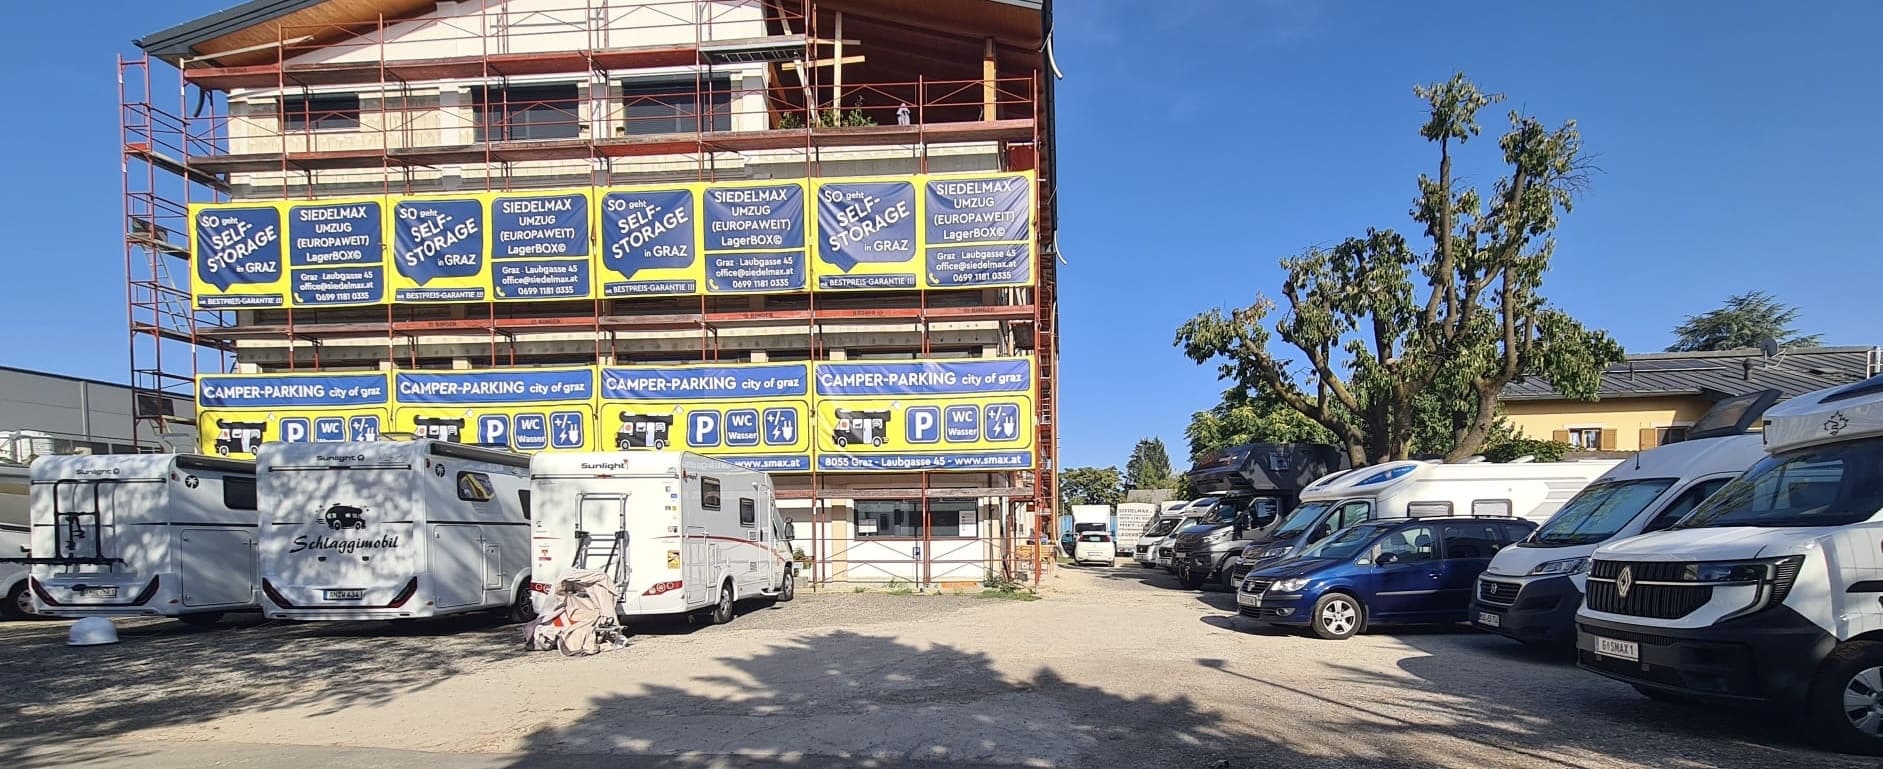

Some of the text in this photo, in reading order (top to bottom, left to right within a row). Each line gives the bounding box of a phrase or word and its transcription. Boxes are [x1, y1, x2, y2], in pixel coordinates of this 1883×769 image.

[937, 181, 1012, 195] SIEDELMAX
[715, 189, 787, 203] SIEDELMAX
[825, 191, 864, 203] SO geht
[503, 199, 572, 213] SIEDELMAX
[608, 200, 647, 211] SO geht
[954, 198, 994, 208] UMZUG
[300, 207, 367, 221] SIEDELMAX
[400, 208, 437, 219] SO geht
[732, 206, 770, 216] UMZUG
[837, 196, 880, 226] SELF-
[201, 216, 238, 227] SO geht
[519, 216, 556, 226] UMZUG
[618, 205, 661, 233] SELF-
[934, 211, 1014, 225] (EUROPAWEIT)
[316, 223, 352, 233] UMZUG
[411, 215, 452, 242] SELF-
[712, 219, 791, 231] (EUROPAWEIT)
[829, 201, 910, 251] STORAGE
[212, 222, 252, 250] SELF-
[500, 228, 574, 242] (EUROPAWEIT)
[612, 207, 688, 259] STORAGE
[298, 236, 369, 249] (EUROPAWEIT)
[406, 218, 478, 266] STORAGE
[865, 240, 908, 251] in GRAZ
[208, 226, 277, 273] STORAGE
[645, 246, 687, 257] in GRAZ
[444, 255, 476, 265] GRAZ
[962, 251, 1003, 260] Laubgasse
[246, 262, 276, 273] GRAZ
[716, 259, 734, 267] Graz
[740, 259, 781, 267] Laubgasse
[936, 260, 1016, 271] office@siedelmax.at
[502, 266, 519, 274] Graz
[526, 266, 566, 275] Laubgasse
[716, 268, 793, 277] office@siedelmax.at
[323, 273, 362, 281] Laubgasse
[502, 275, 578, 284] office@siedelmax.at
[830, 278, 905, 286] BESTPREIS-GARANTIE
[300, 282, 374, 290] office@siedelmax.at
[556, 286, 574, 294] 0335
[613, 284, 686, 293] BESTPREIS-GARANTIE
[606, 377, 799, 390] CAMPER-PARKING city of graz
[821, 372, 1021, 387] CAMPER-PARKING city of graz
[204, 385, 380, 399] CAMPER-PARKING city of graz
[400, 381, 585, 395] CAMPER-PARKING city of graz
[732, 415, 752, 426] WC
[952, 411, 972, 422] WC
[321, 422, 339, 433] WC
[521, 419, 540, 429] WC
[696, 416, 714, 442] P
[916, 412, 933, 438] P
[287, 423, 304, 442] P
[487, 420, 504, 443] P
[728, 432, 758, 440] Wasser
[948, 427, 977, 436] Wasser
[517, 435, 545, 443] Wasser
[825, 458, 848, 466] 8055
[852, 457, 872, 466] Graz
[882, 458, 930, 468] Laubgasse
[934, 456, 945, 465] 45
[954, 455, 1021, 465] www.smax.at
[290, 534, 399, 554] Schlaggimobil
